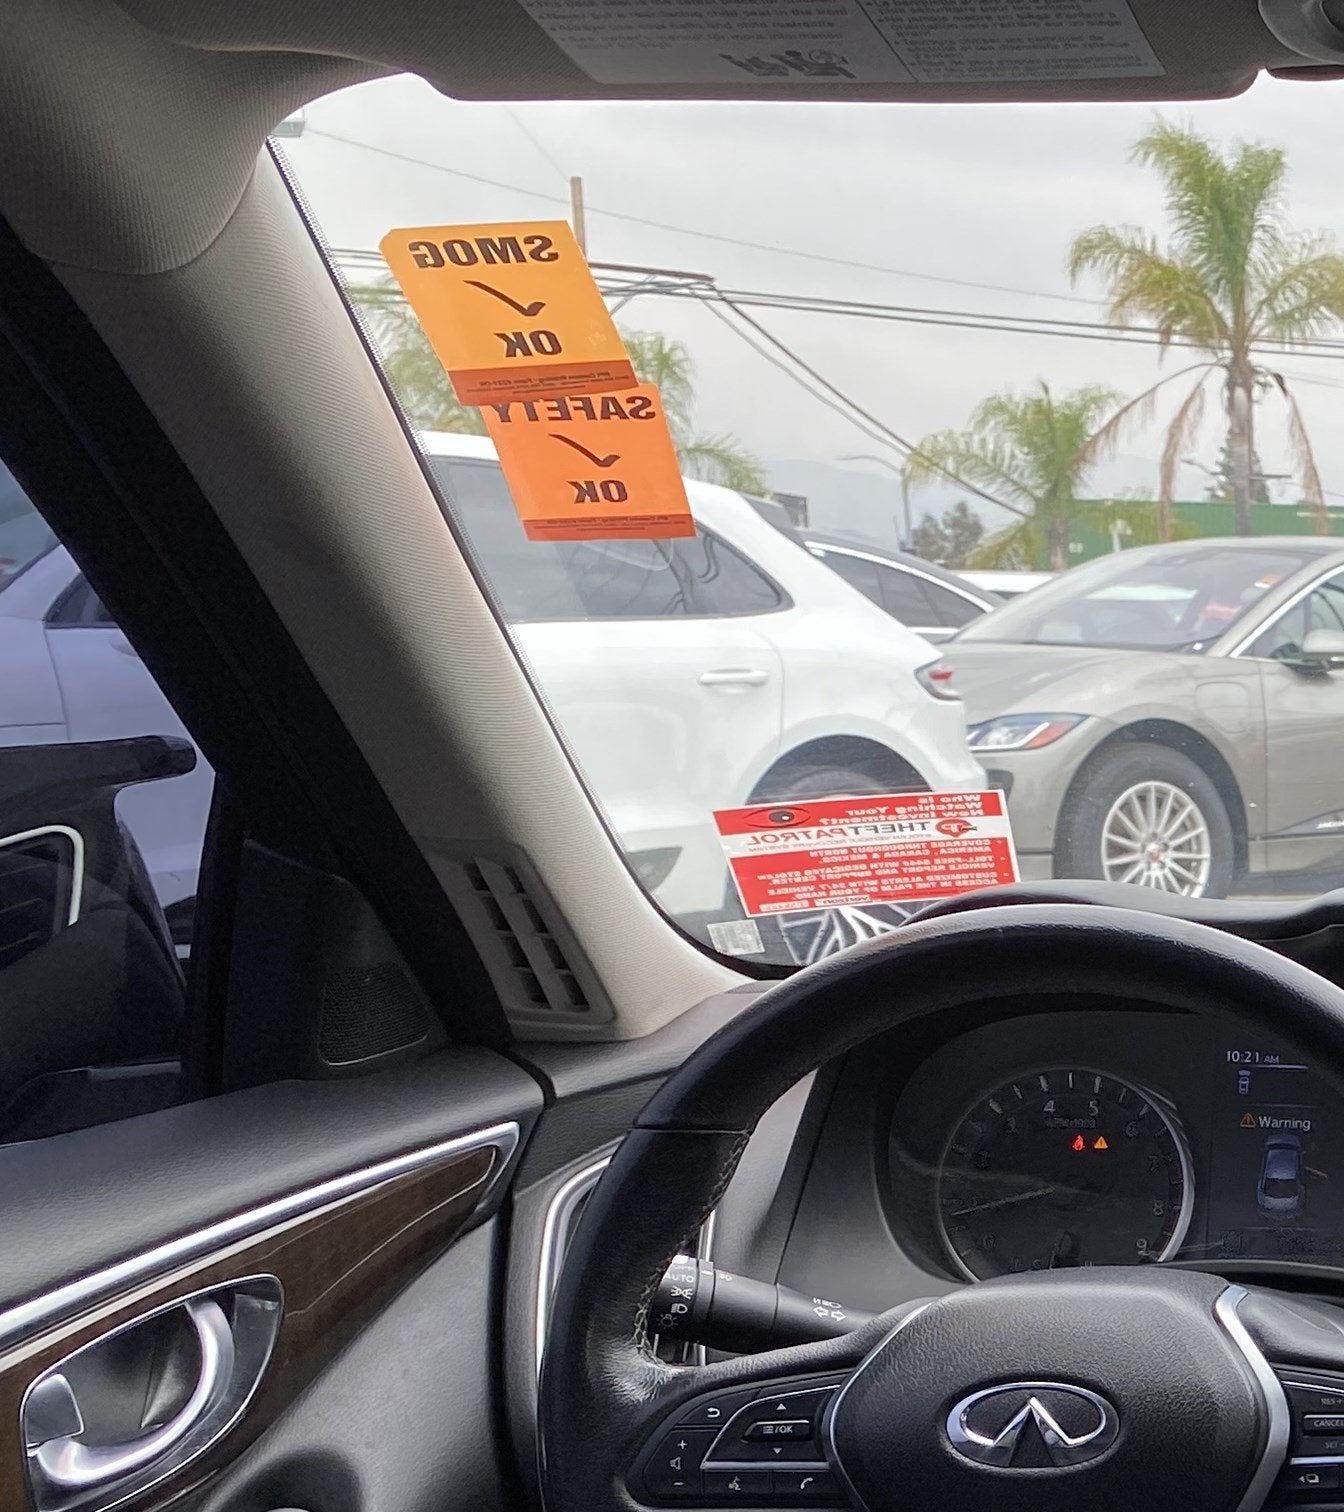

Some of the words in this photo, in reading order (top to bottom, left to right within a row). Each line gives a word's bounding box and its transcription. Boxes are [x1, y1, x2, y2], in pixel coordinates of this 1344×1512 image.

[1226, 1050, 1260, 1063] 10:21
[1258, 1115, 1312, 1132] Warning
[1313, 1419, 1344, 1428] CANCEL
